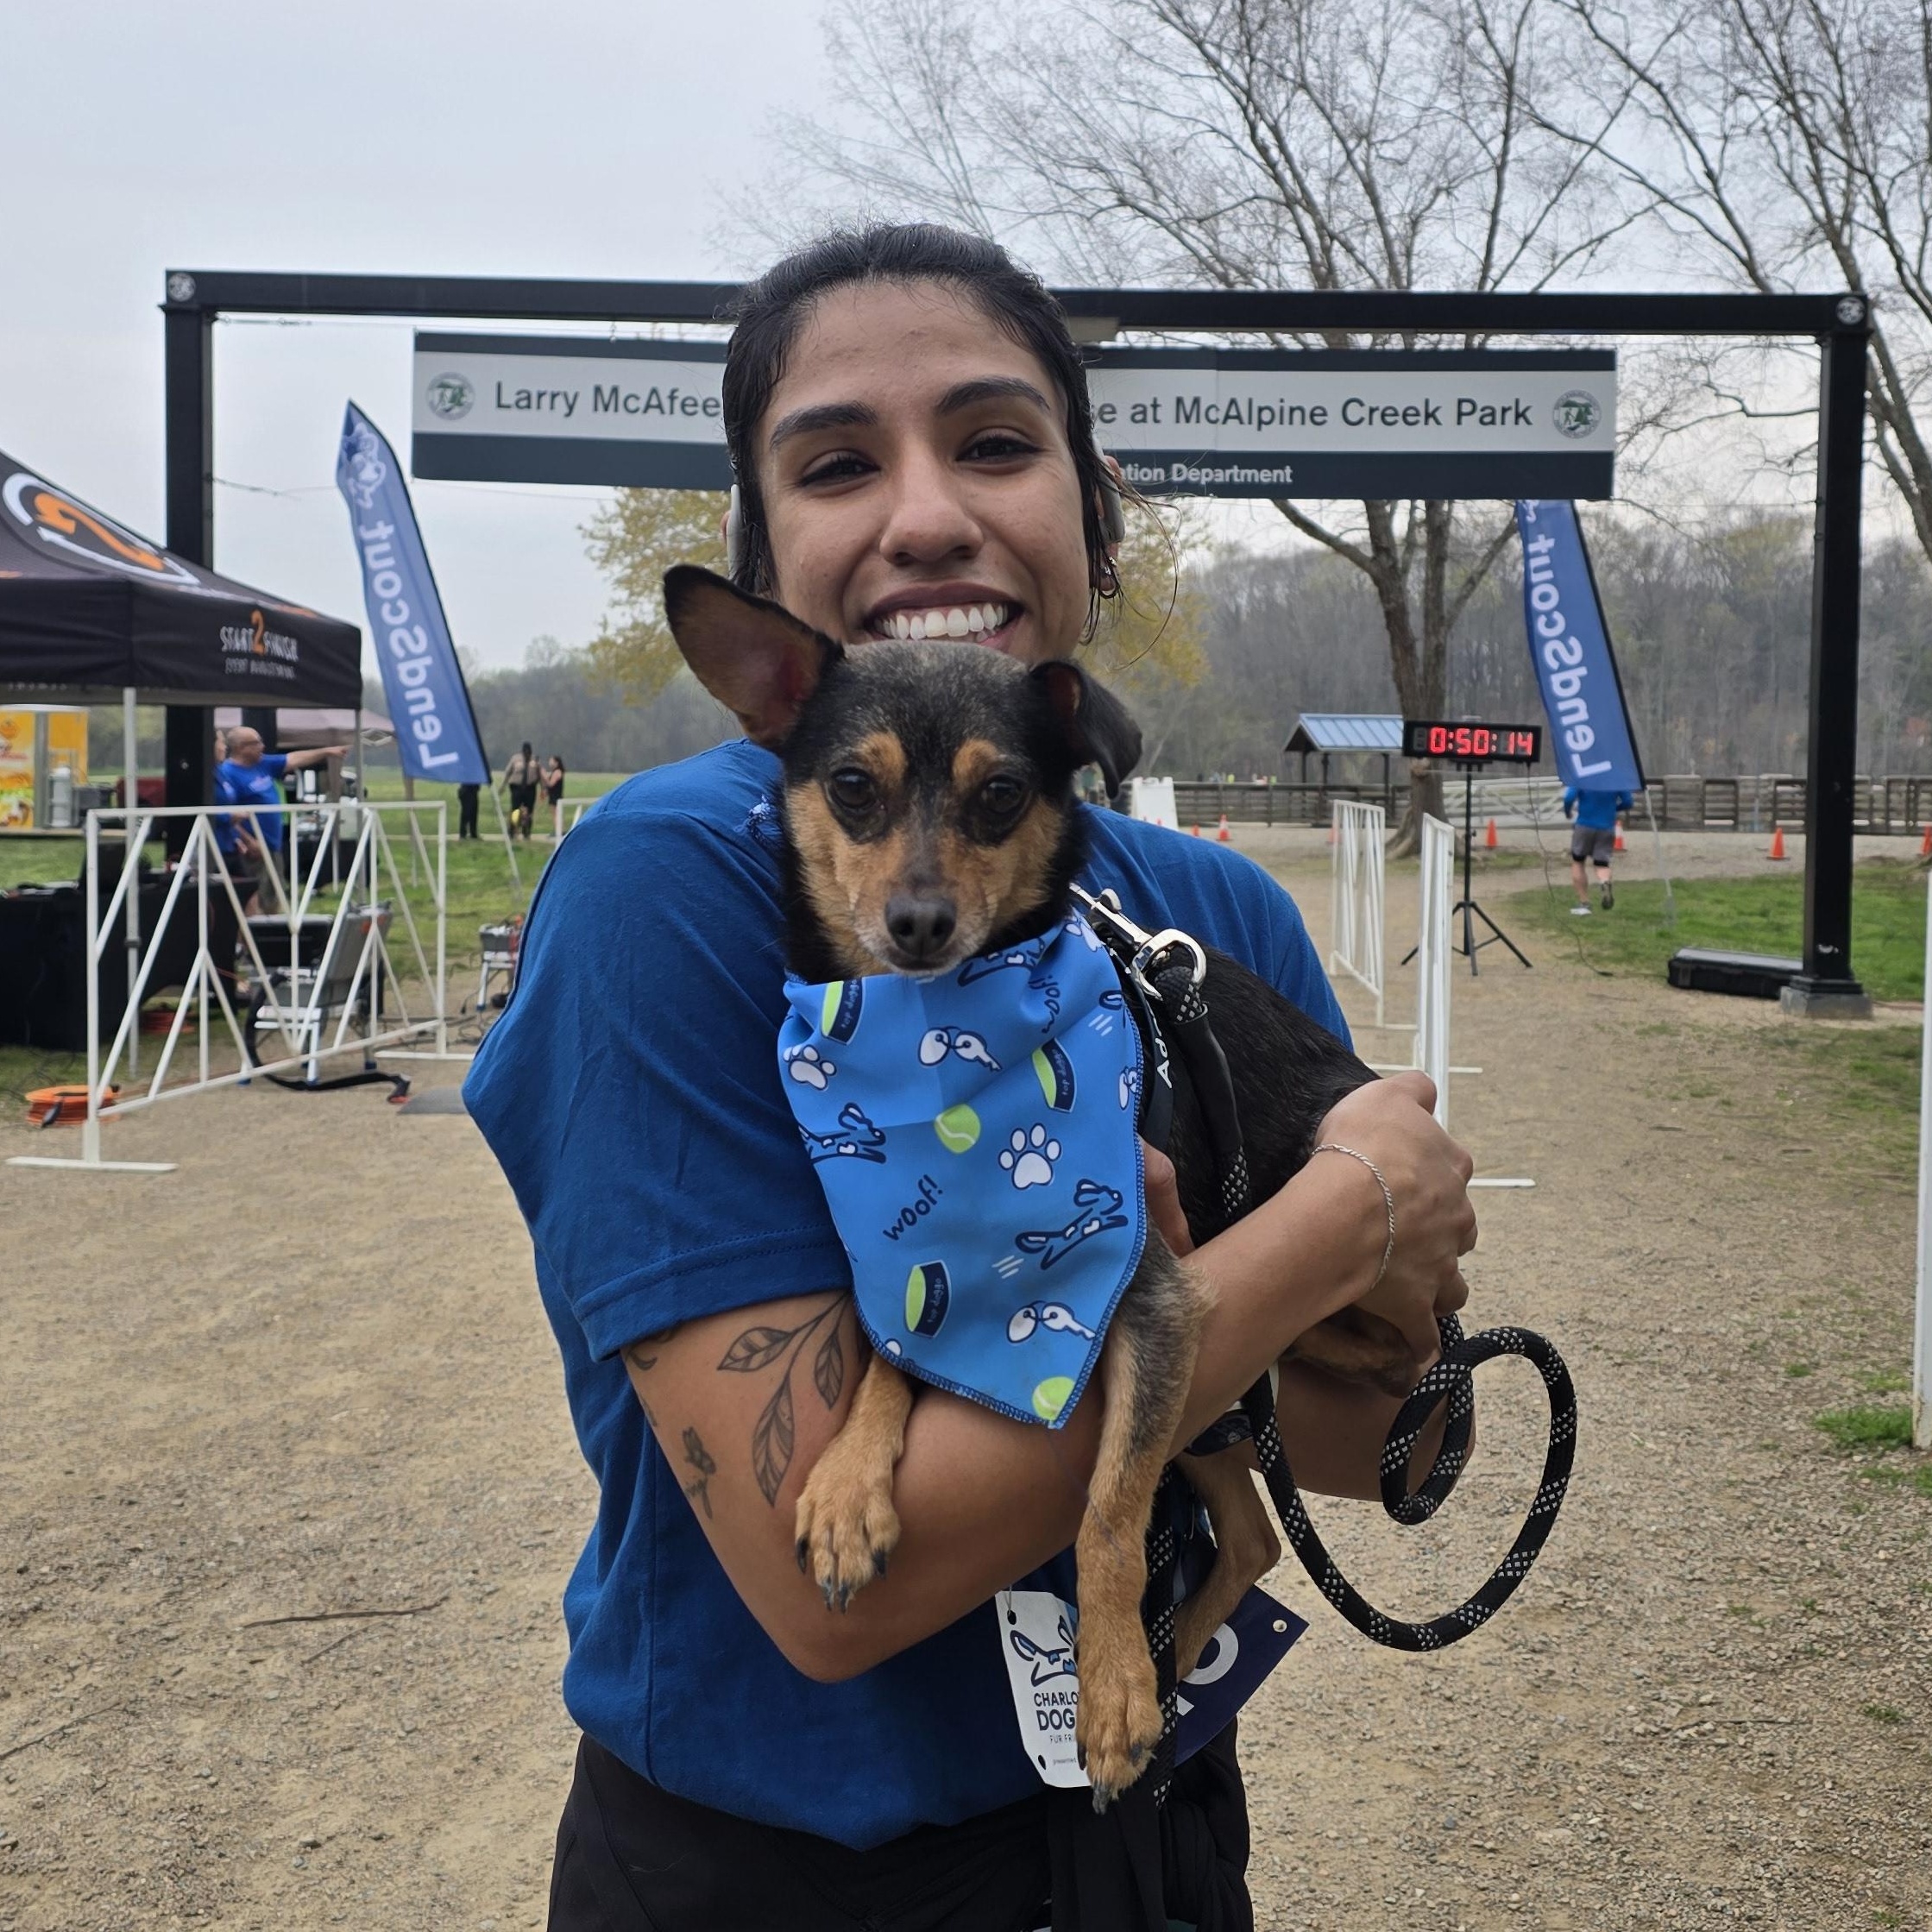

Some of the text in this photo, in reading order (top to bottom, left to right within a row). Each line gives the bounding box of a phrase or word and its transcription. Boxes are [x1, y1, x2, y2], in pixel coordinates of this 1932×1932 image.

[495, 381, 579, 418] Larry
[592, 383, 721, 418] McAfee
[1130, 396, 1161, 424] at
[1174, 395, 1329, 432] McAlpine
[1341, 397, 1444, 427] Creek
[1456, 397, 1533, 426] Park
[1171, 463, 1293, 485] Department
[1430, 727, 1533, 756] 0:50:14
[882, 1174, 943, 1242] woof!
[1034, 1691, 1079, 1707] CHARLO
[1035, 1709, 1076, 1732] DOG
